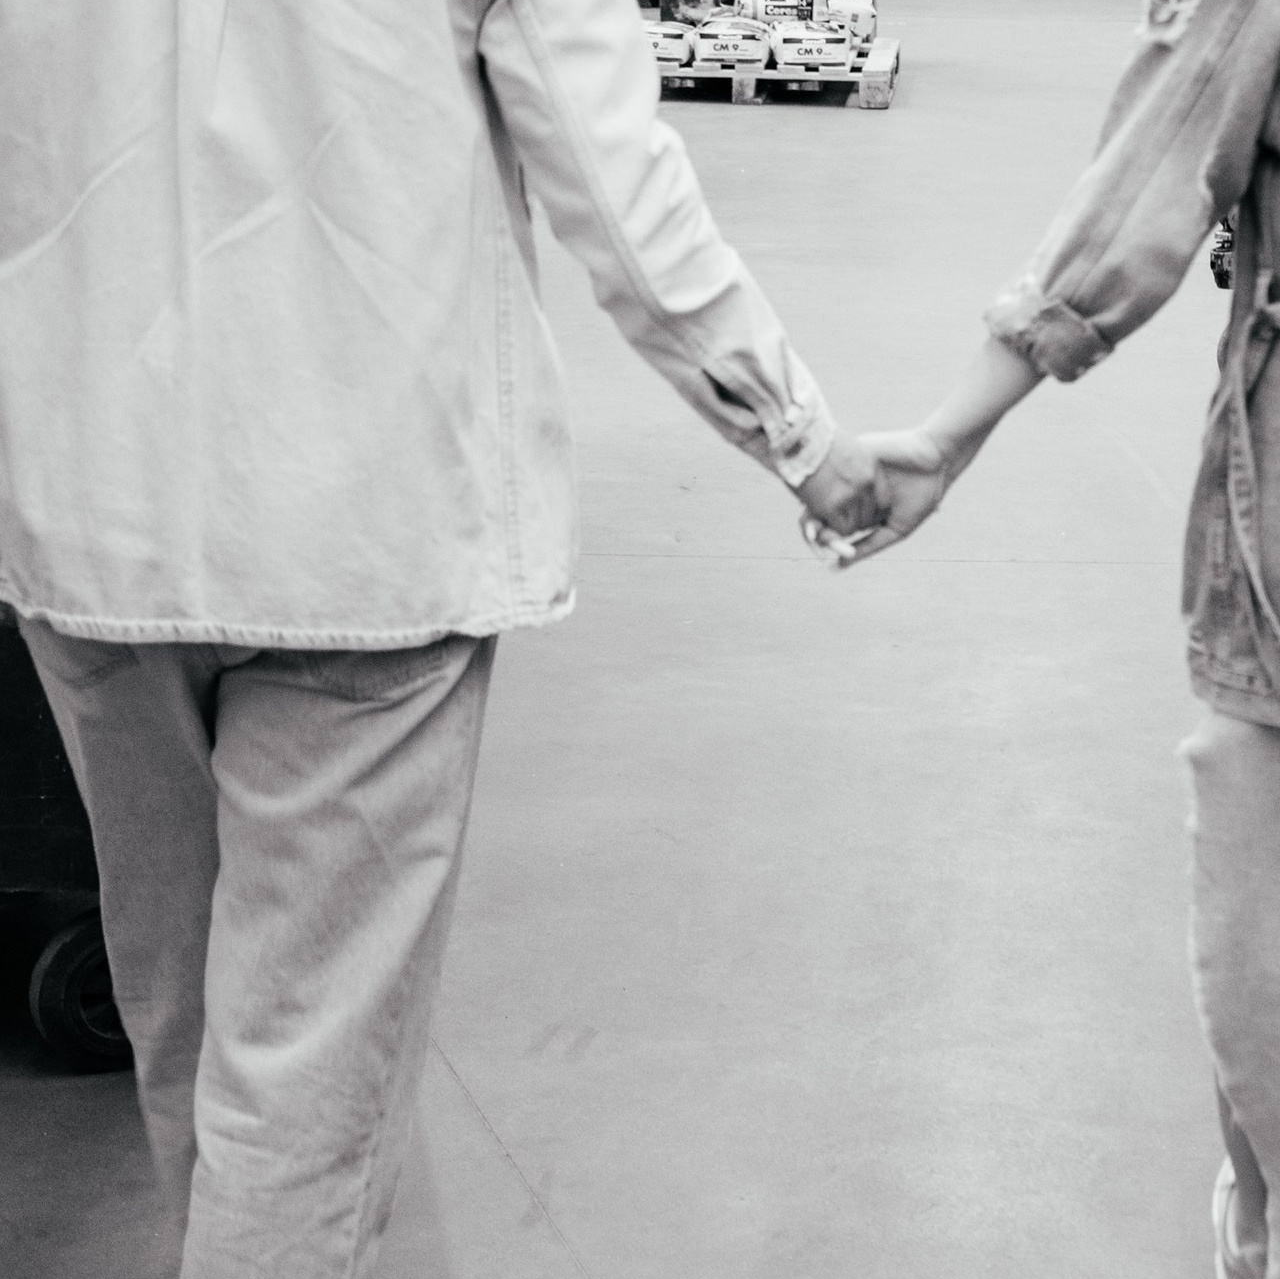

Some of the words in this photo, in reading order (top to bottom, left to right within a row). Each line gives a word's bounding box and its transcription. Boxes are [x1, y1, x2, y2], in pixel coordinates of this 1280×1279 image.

[713, 43, 729, 52] CM
[732, 43, 740, 52] 9
[797, 47, 813, 56] CM
[816, 47, 824, 56] 9
